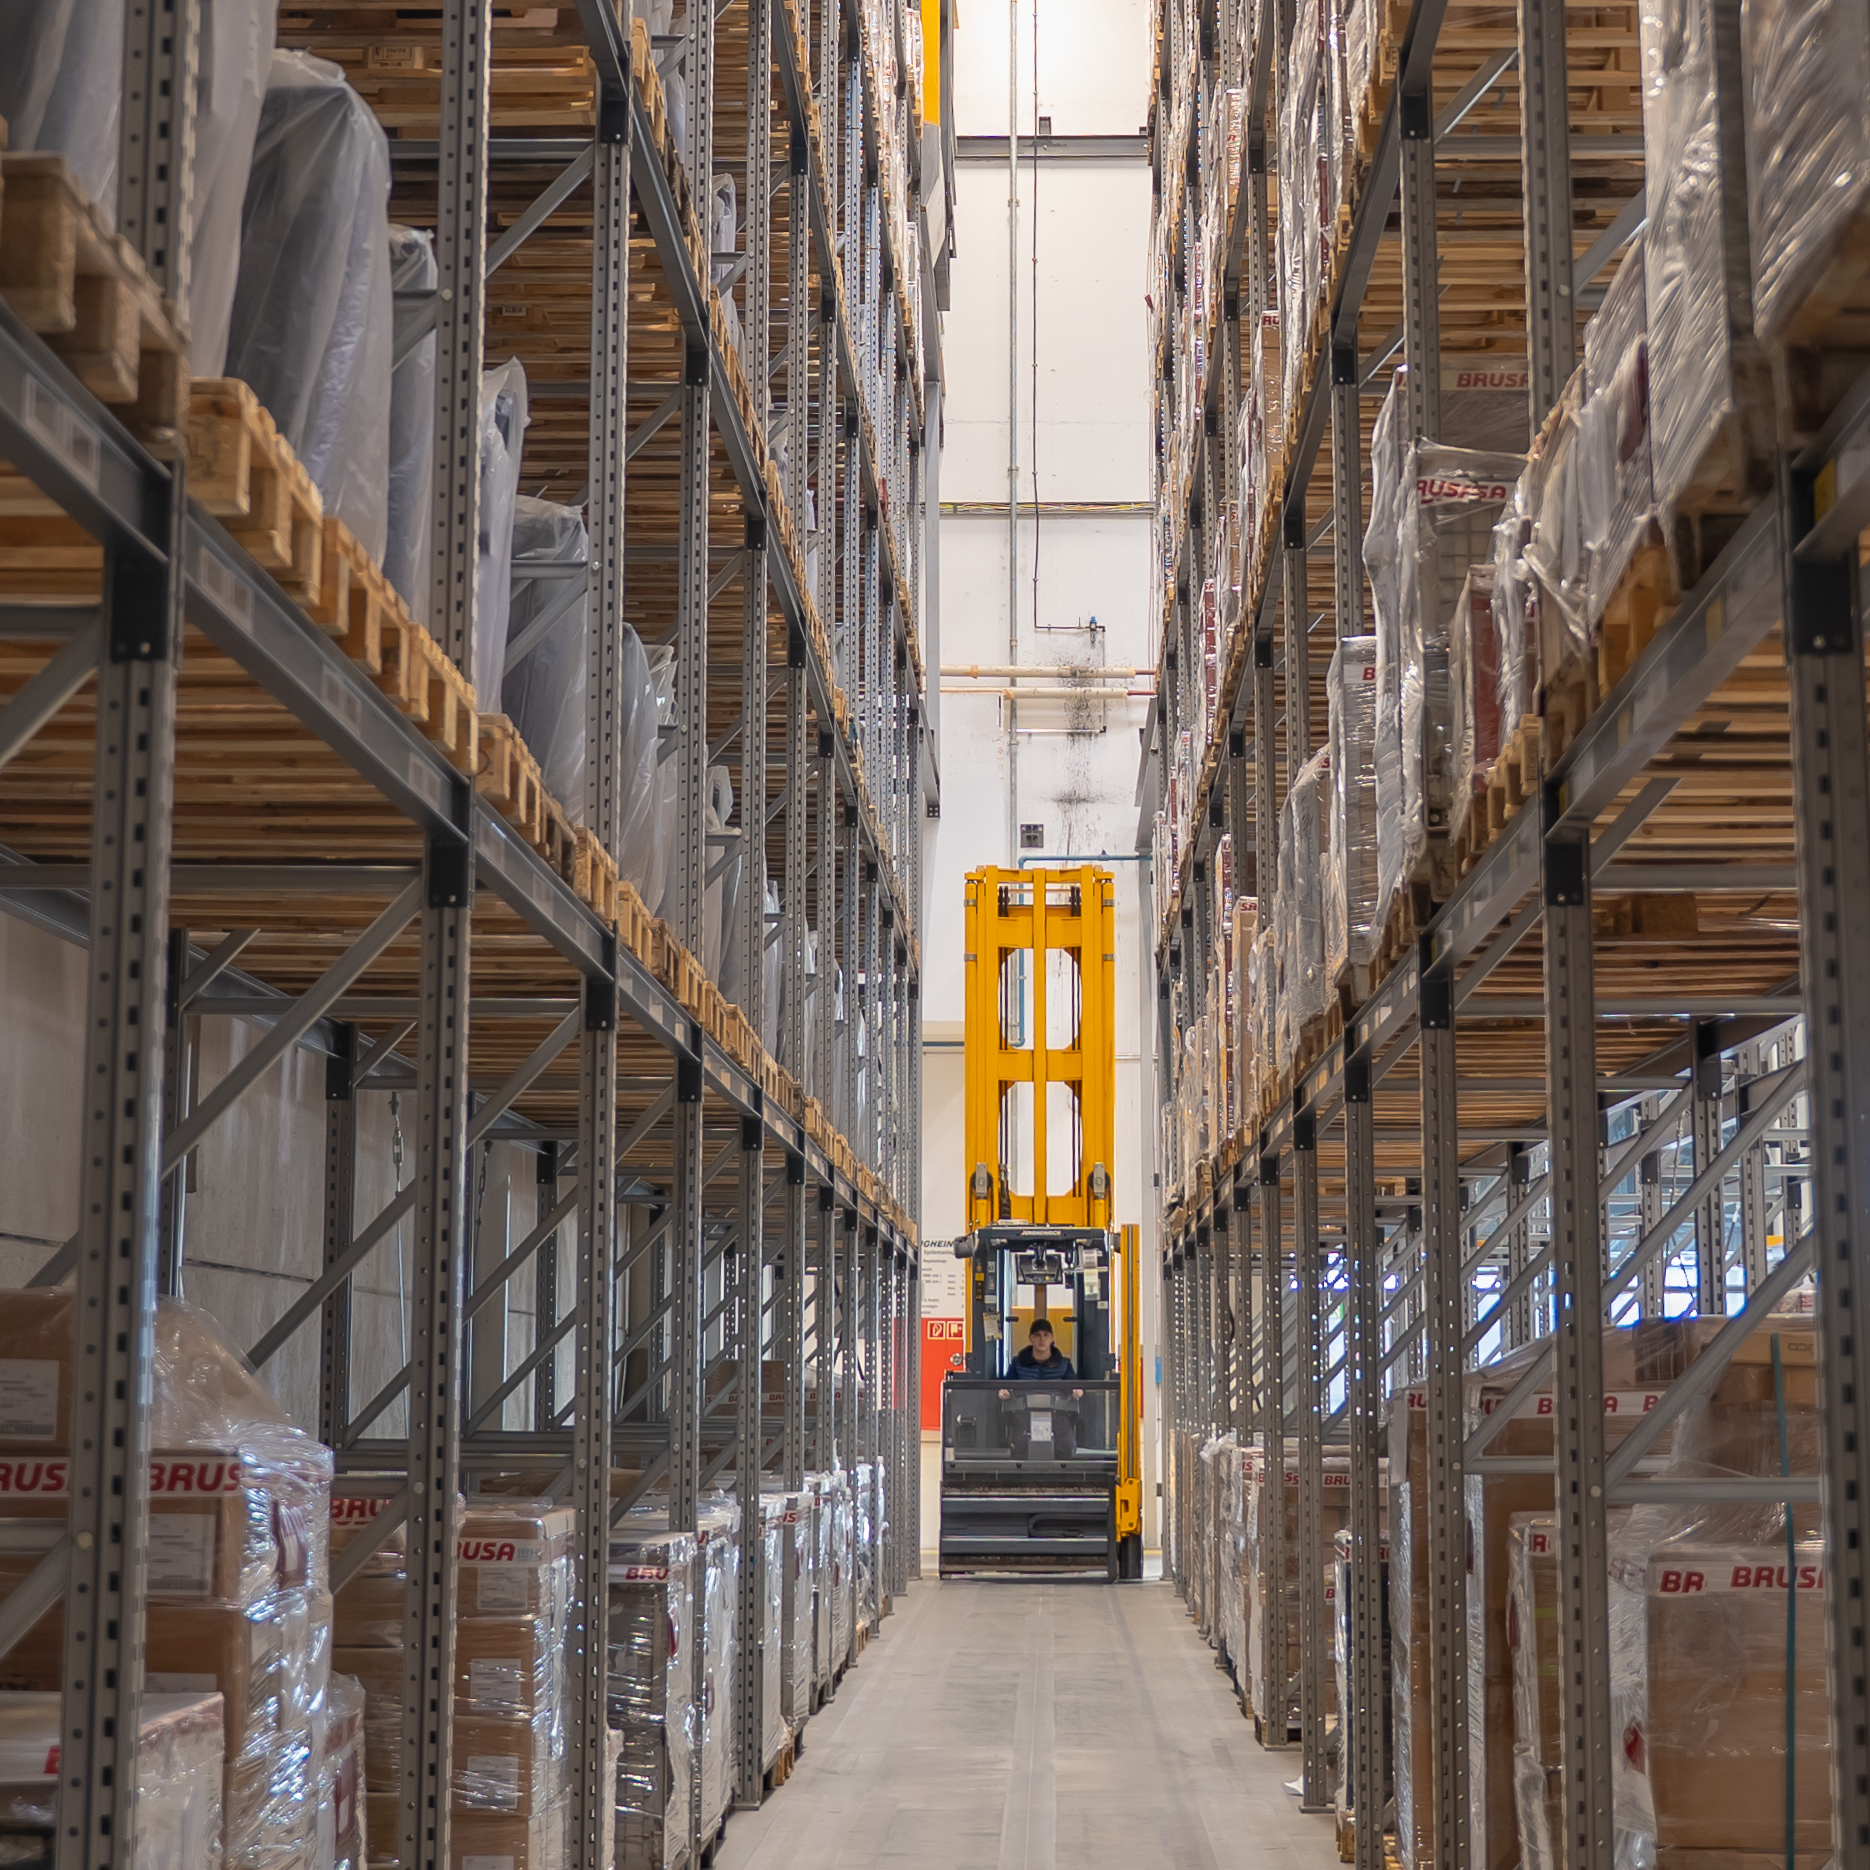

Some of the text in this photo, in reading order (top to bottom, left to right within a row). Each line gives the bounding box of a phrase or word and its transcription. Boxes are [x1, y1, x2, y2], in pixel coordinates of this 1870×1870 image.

[148, 1463, 242, 1491] BRUS
[1324, 1475, 1351, 1485] BRU
[625, 1567, 670, 1580] BRU
[1731, 1566, 1824, 1588] BRUS
